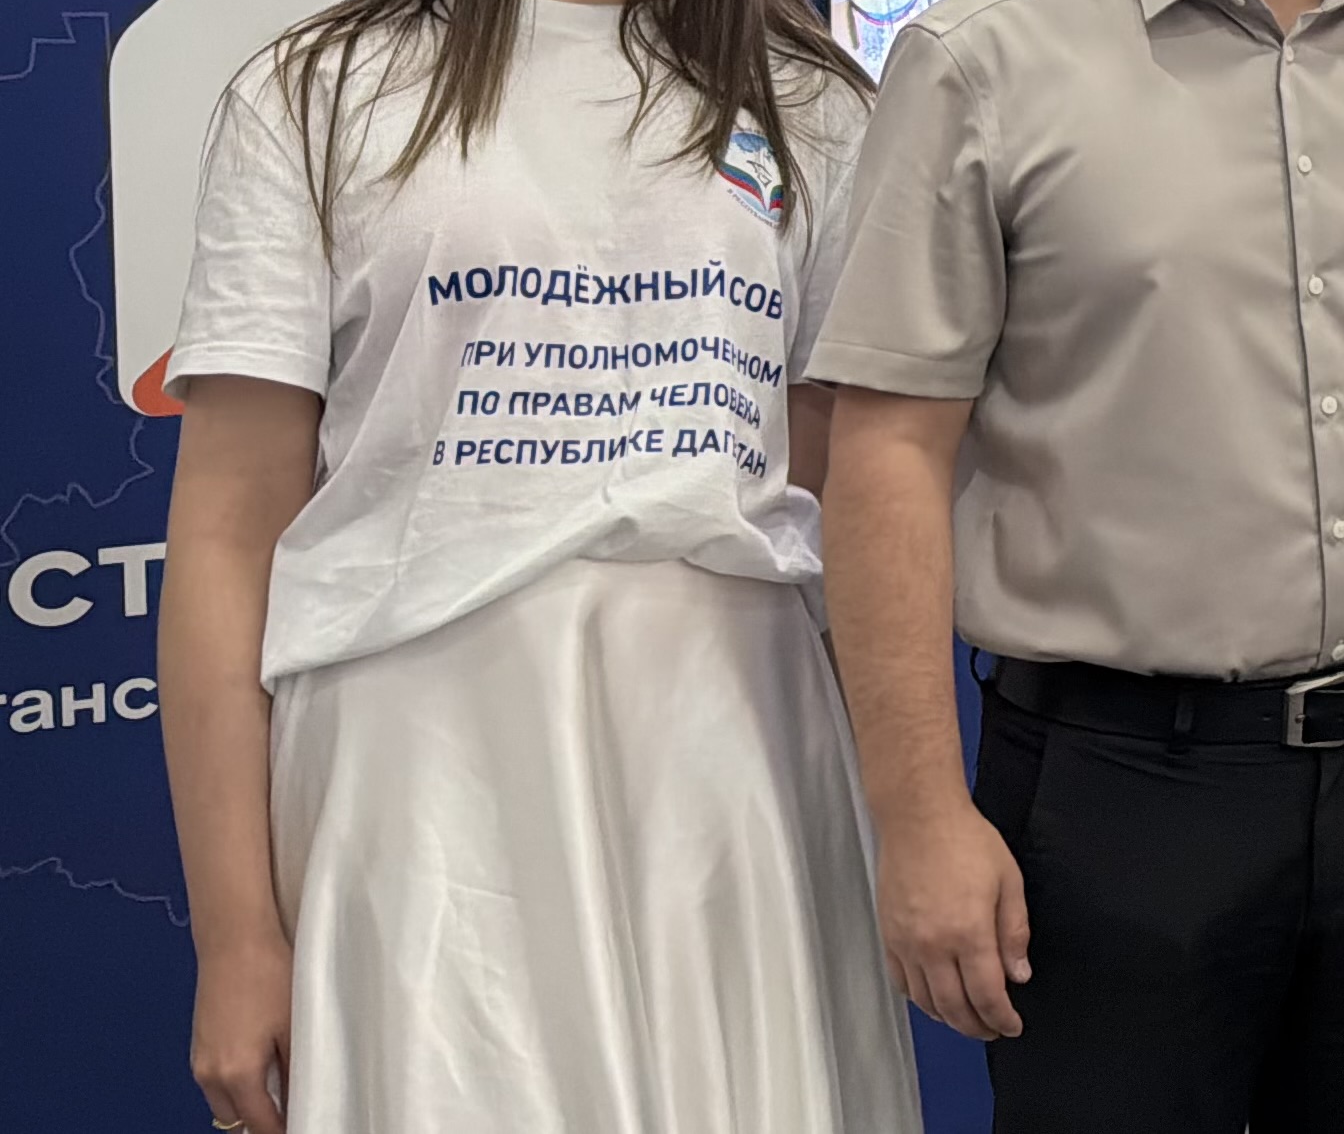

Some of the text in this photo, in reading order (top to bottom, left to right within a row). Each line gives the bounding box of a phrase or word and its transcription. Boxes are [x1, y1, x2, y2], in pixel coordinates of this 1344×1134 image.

[428, 259, 726, 307] МОЛОДЁЖНЫЙ
[461, 341, 516, 367] ПРИ
[457, 382, 762, 429] ПО ПРАВАМ ЧЕЛОВЕКА
[433, 440, 445, 465] В
[0, 677, 159, 733] анс
